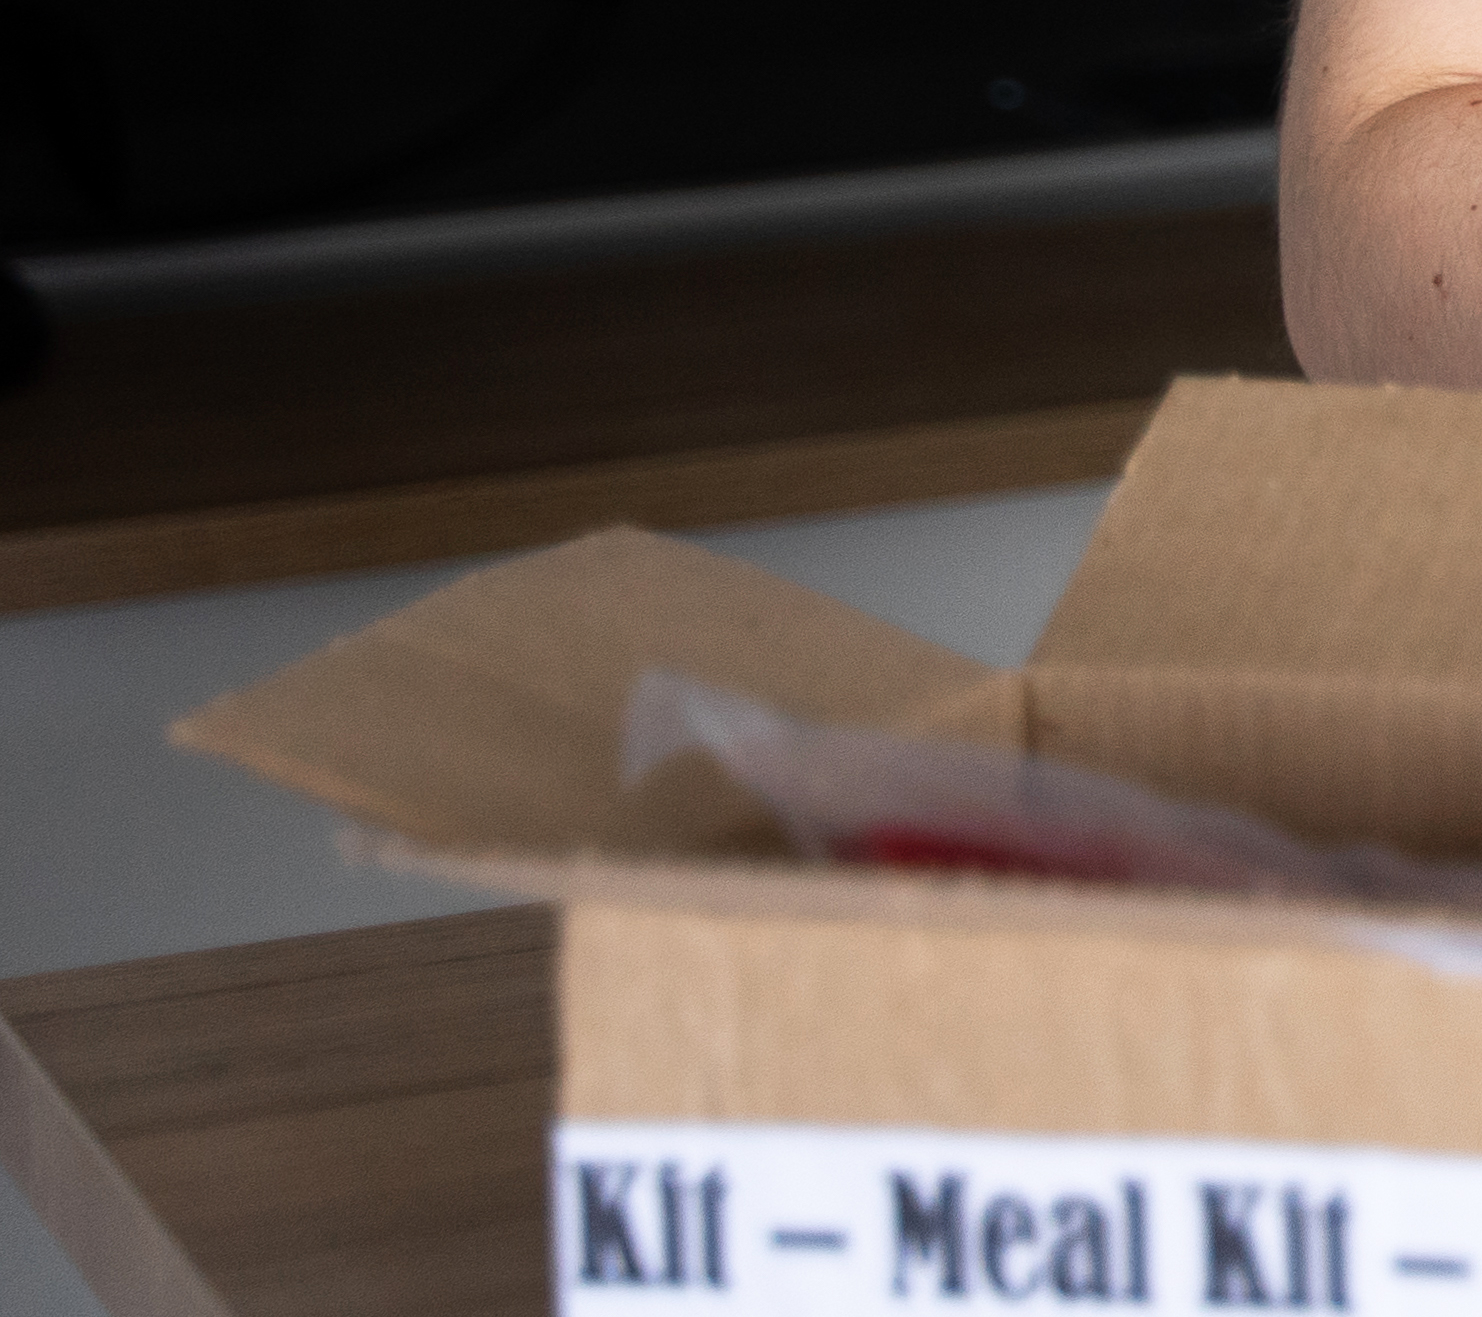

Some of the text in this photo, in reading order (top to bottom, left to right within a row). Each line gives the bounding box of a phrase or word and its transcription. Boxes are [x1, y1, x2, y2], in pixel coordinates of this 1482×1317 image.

[577, 1160, 727, 1292] Kit
[888, 1166, 1158, 1304] Meal
[1197, 1180, 1354, 1314] Kit
